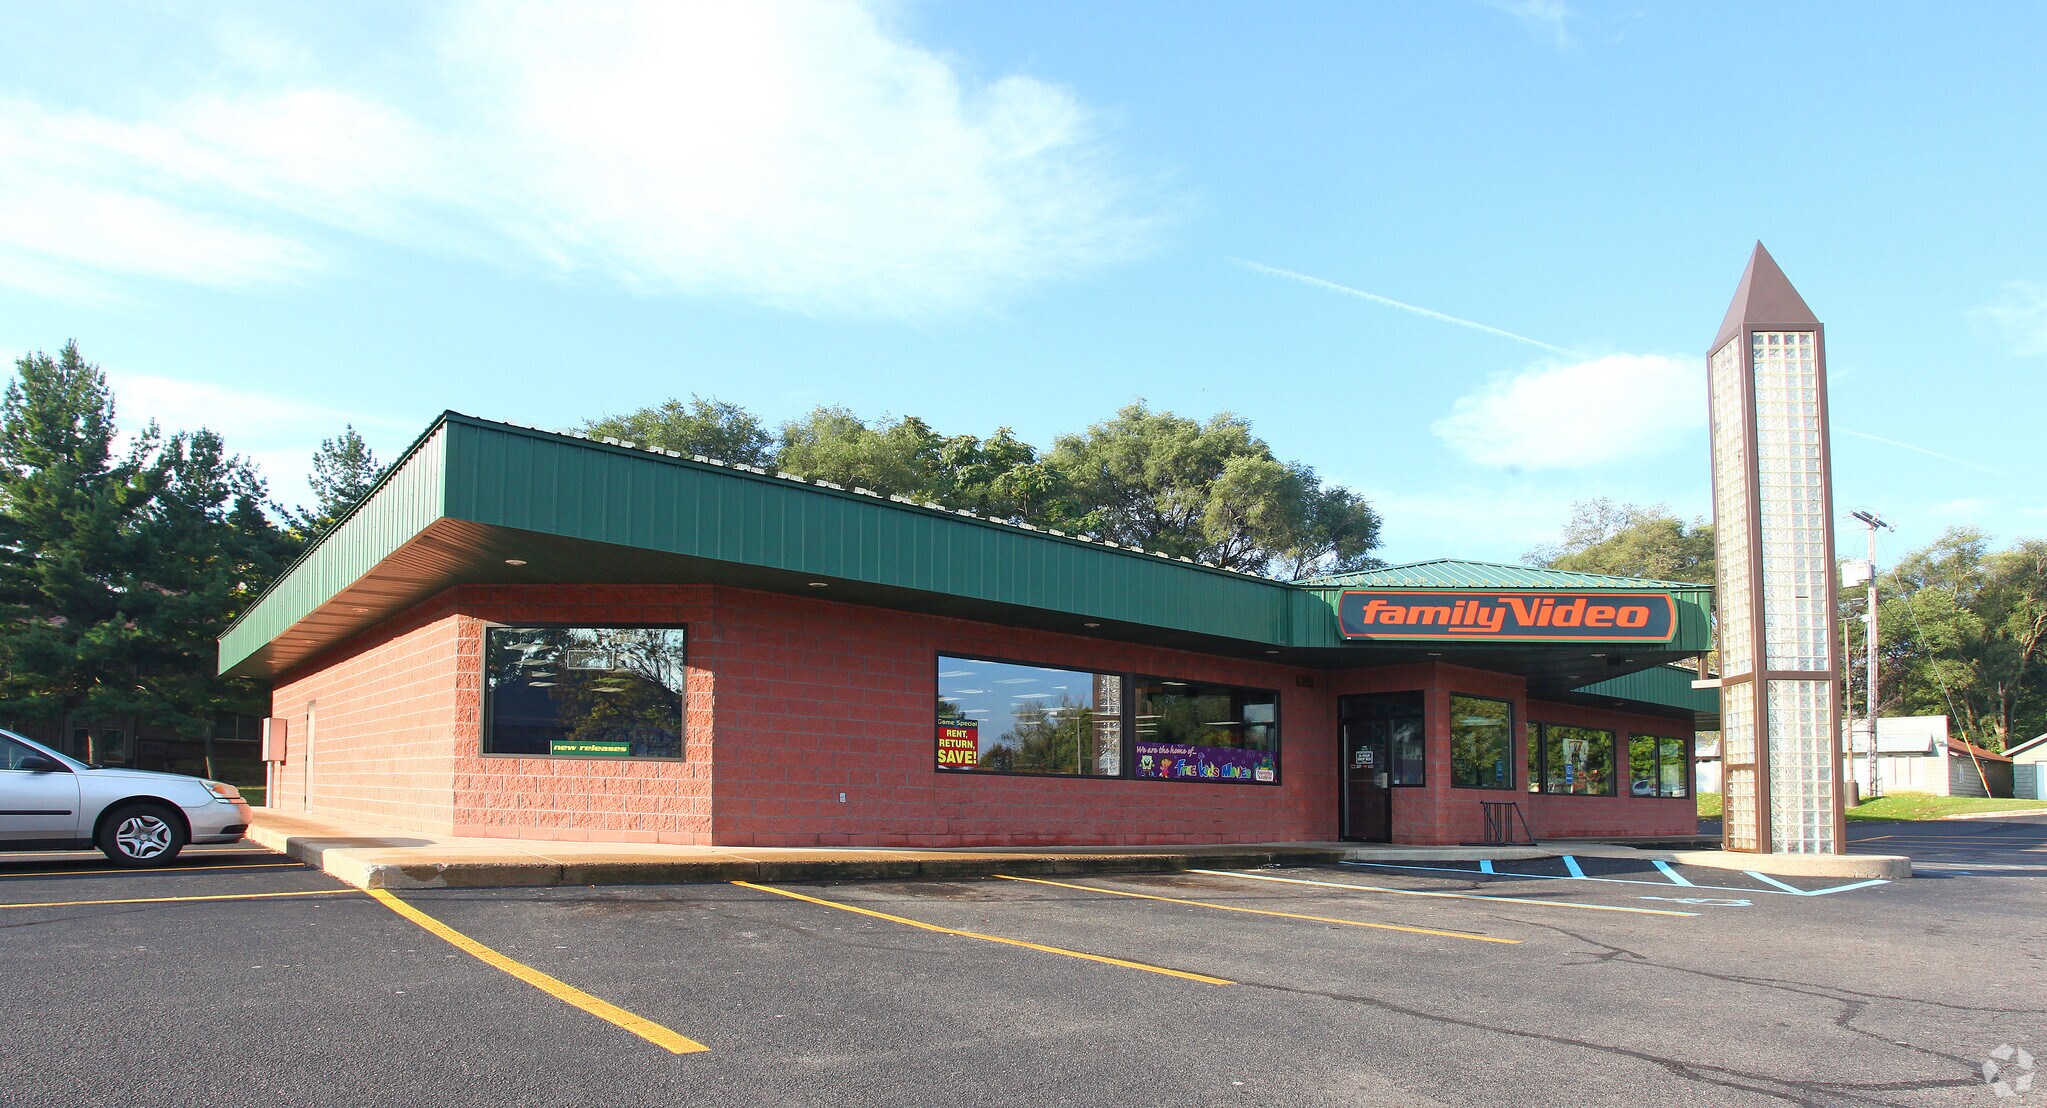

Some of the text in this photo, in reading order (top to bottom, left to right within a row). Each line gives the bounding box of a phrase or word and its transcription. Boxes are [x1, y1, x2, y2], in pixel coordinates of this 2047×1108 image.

[946, 729, 968, 738] RENT,
[579, 744, 627, 752] releases
[939, 739, 976, 750] RETURN,
[1136, 745, 1147, 753] We
[1158, 745, 1169, 754] the
[937, 749, 977, 764] SAVE!
